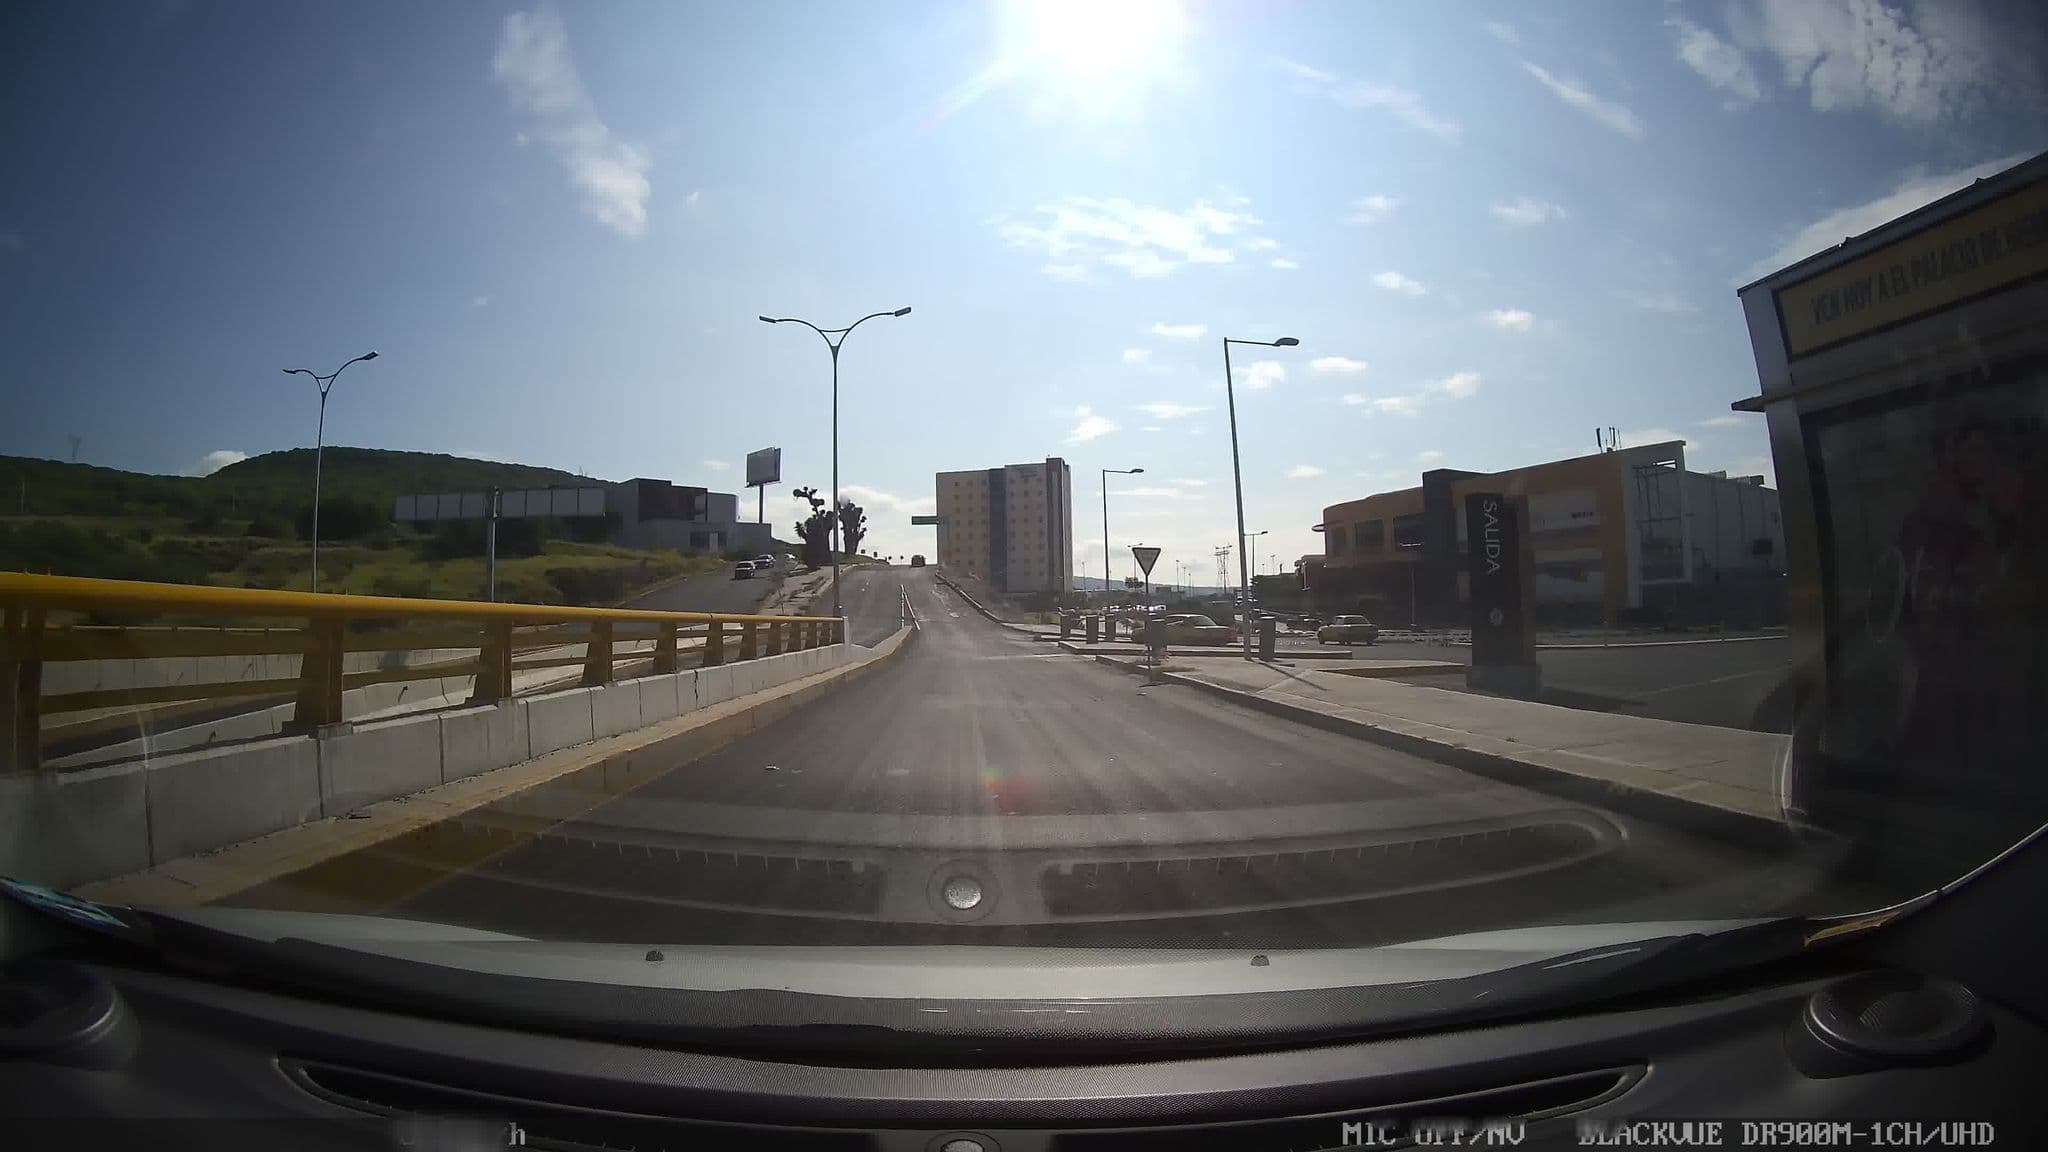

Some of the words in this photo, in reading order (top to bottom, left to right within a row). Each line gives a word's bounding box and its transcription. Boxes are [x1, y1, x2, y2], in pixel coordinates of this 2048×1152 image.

[1842, 276, 1873, 313] HOY
[1890, 263, 1910, 296] EL
[1482, 499, 1502, 575] SALIDA
